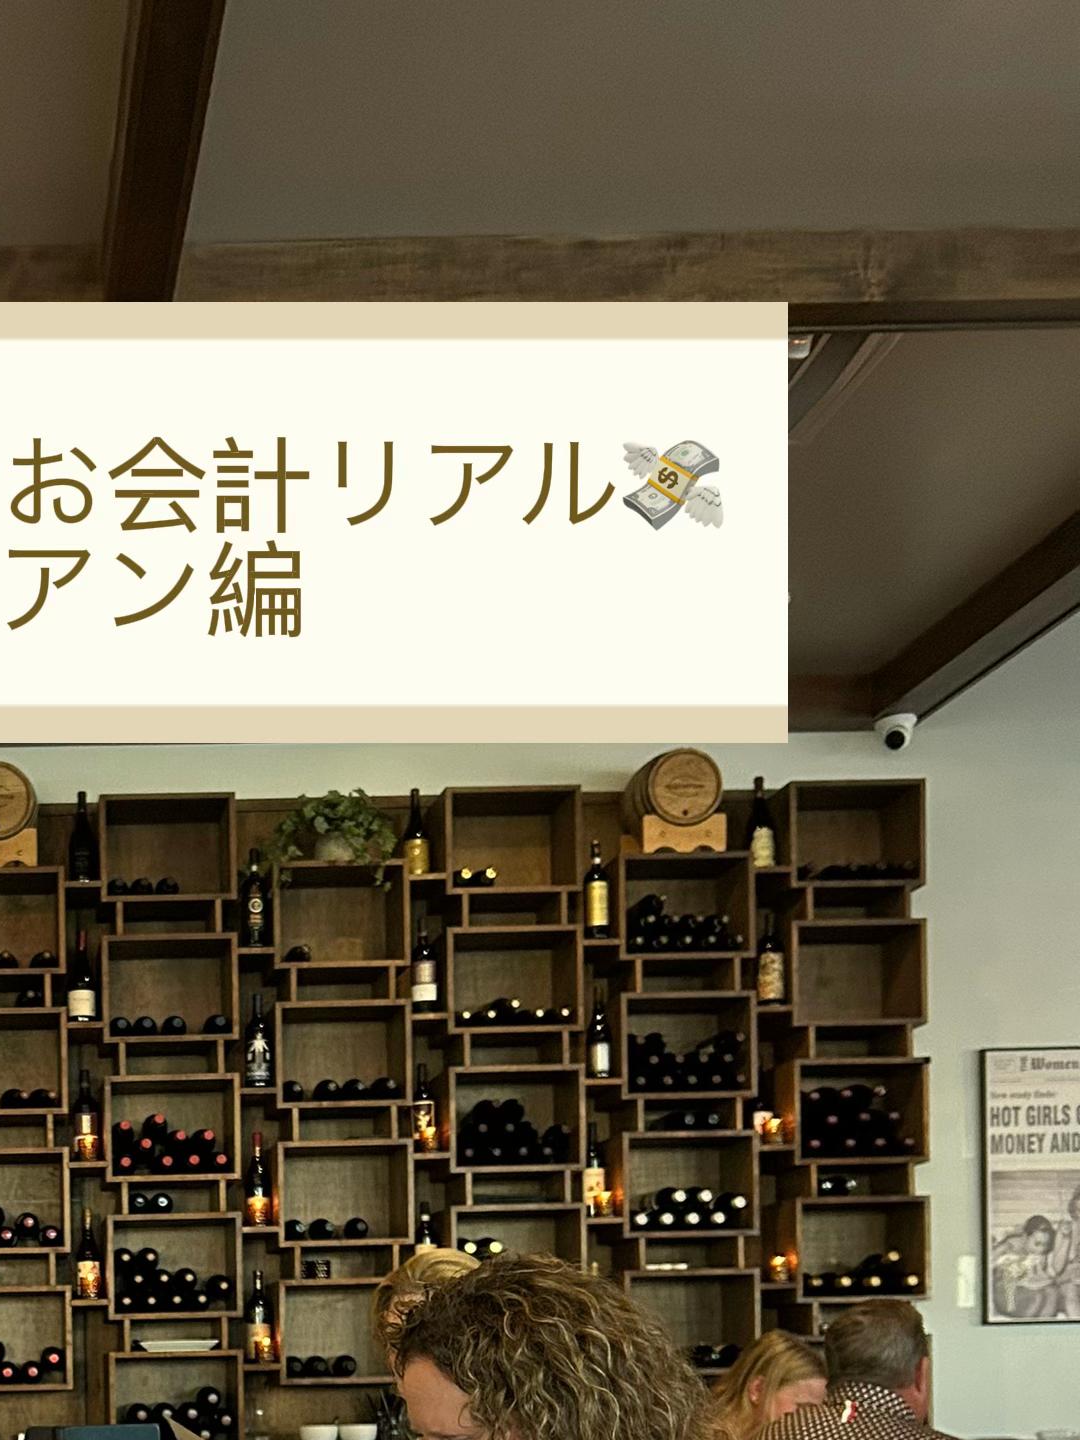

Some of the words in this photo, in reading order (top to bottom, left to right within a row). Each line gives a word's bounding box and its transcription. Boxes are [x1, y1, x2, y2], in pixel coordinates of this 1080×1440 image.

[989, 1105, 1022, 1128] HOT
[1025, 1104, 1071, 1127] GIRLS
[990, 1132, 1046, 1155] MONEY
[1049, 1131, 1080, 1154] AND
